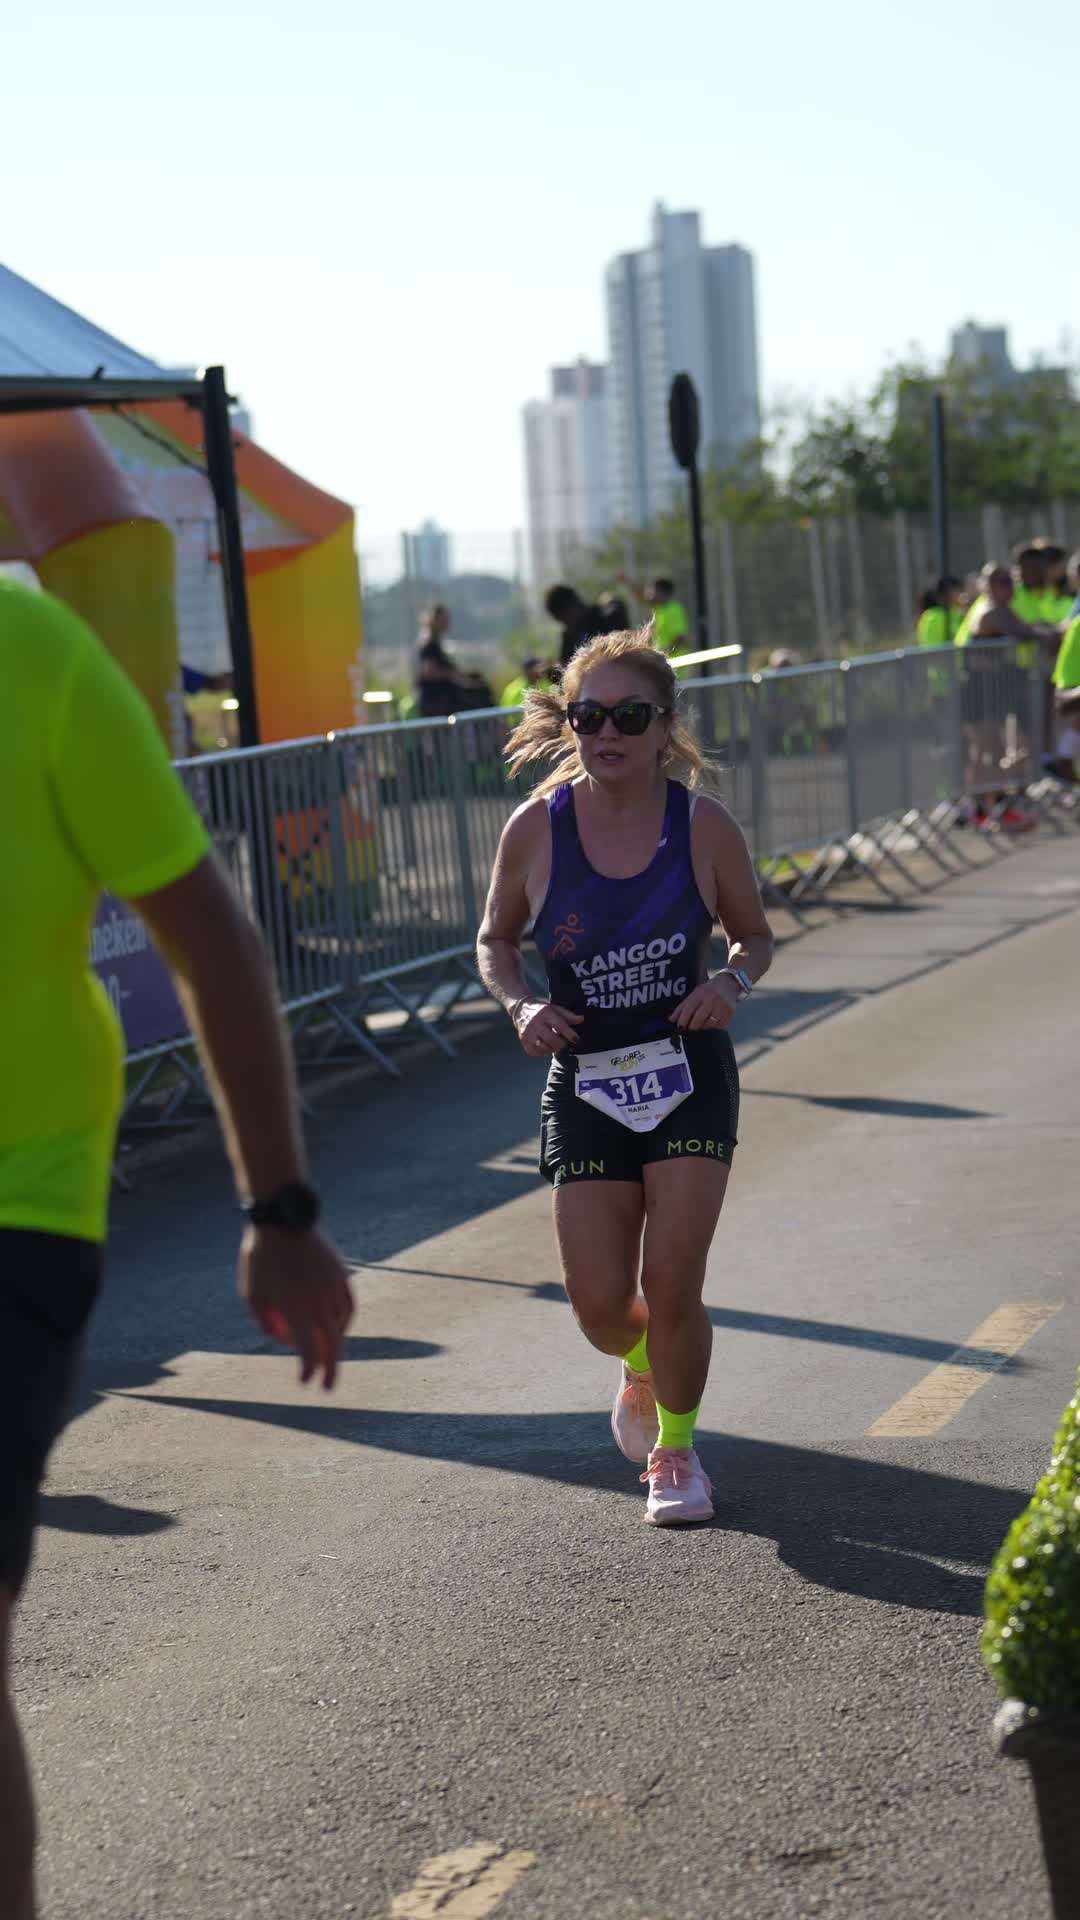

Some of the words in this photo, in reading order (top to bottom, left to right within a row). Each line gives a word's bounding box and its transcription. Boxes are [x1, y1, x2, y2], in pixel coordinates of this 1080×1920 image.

[570, 932, 687, 978] KANGOO
[580, 959, 671, 996] STREET
[609, 1071, 663, 1106] 314
[627, 1104, 650, 1113] MARIA
[558, 1159, 605, 1177] RUN
[667, 1138, 726, 1158] MORE
